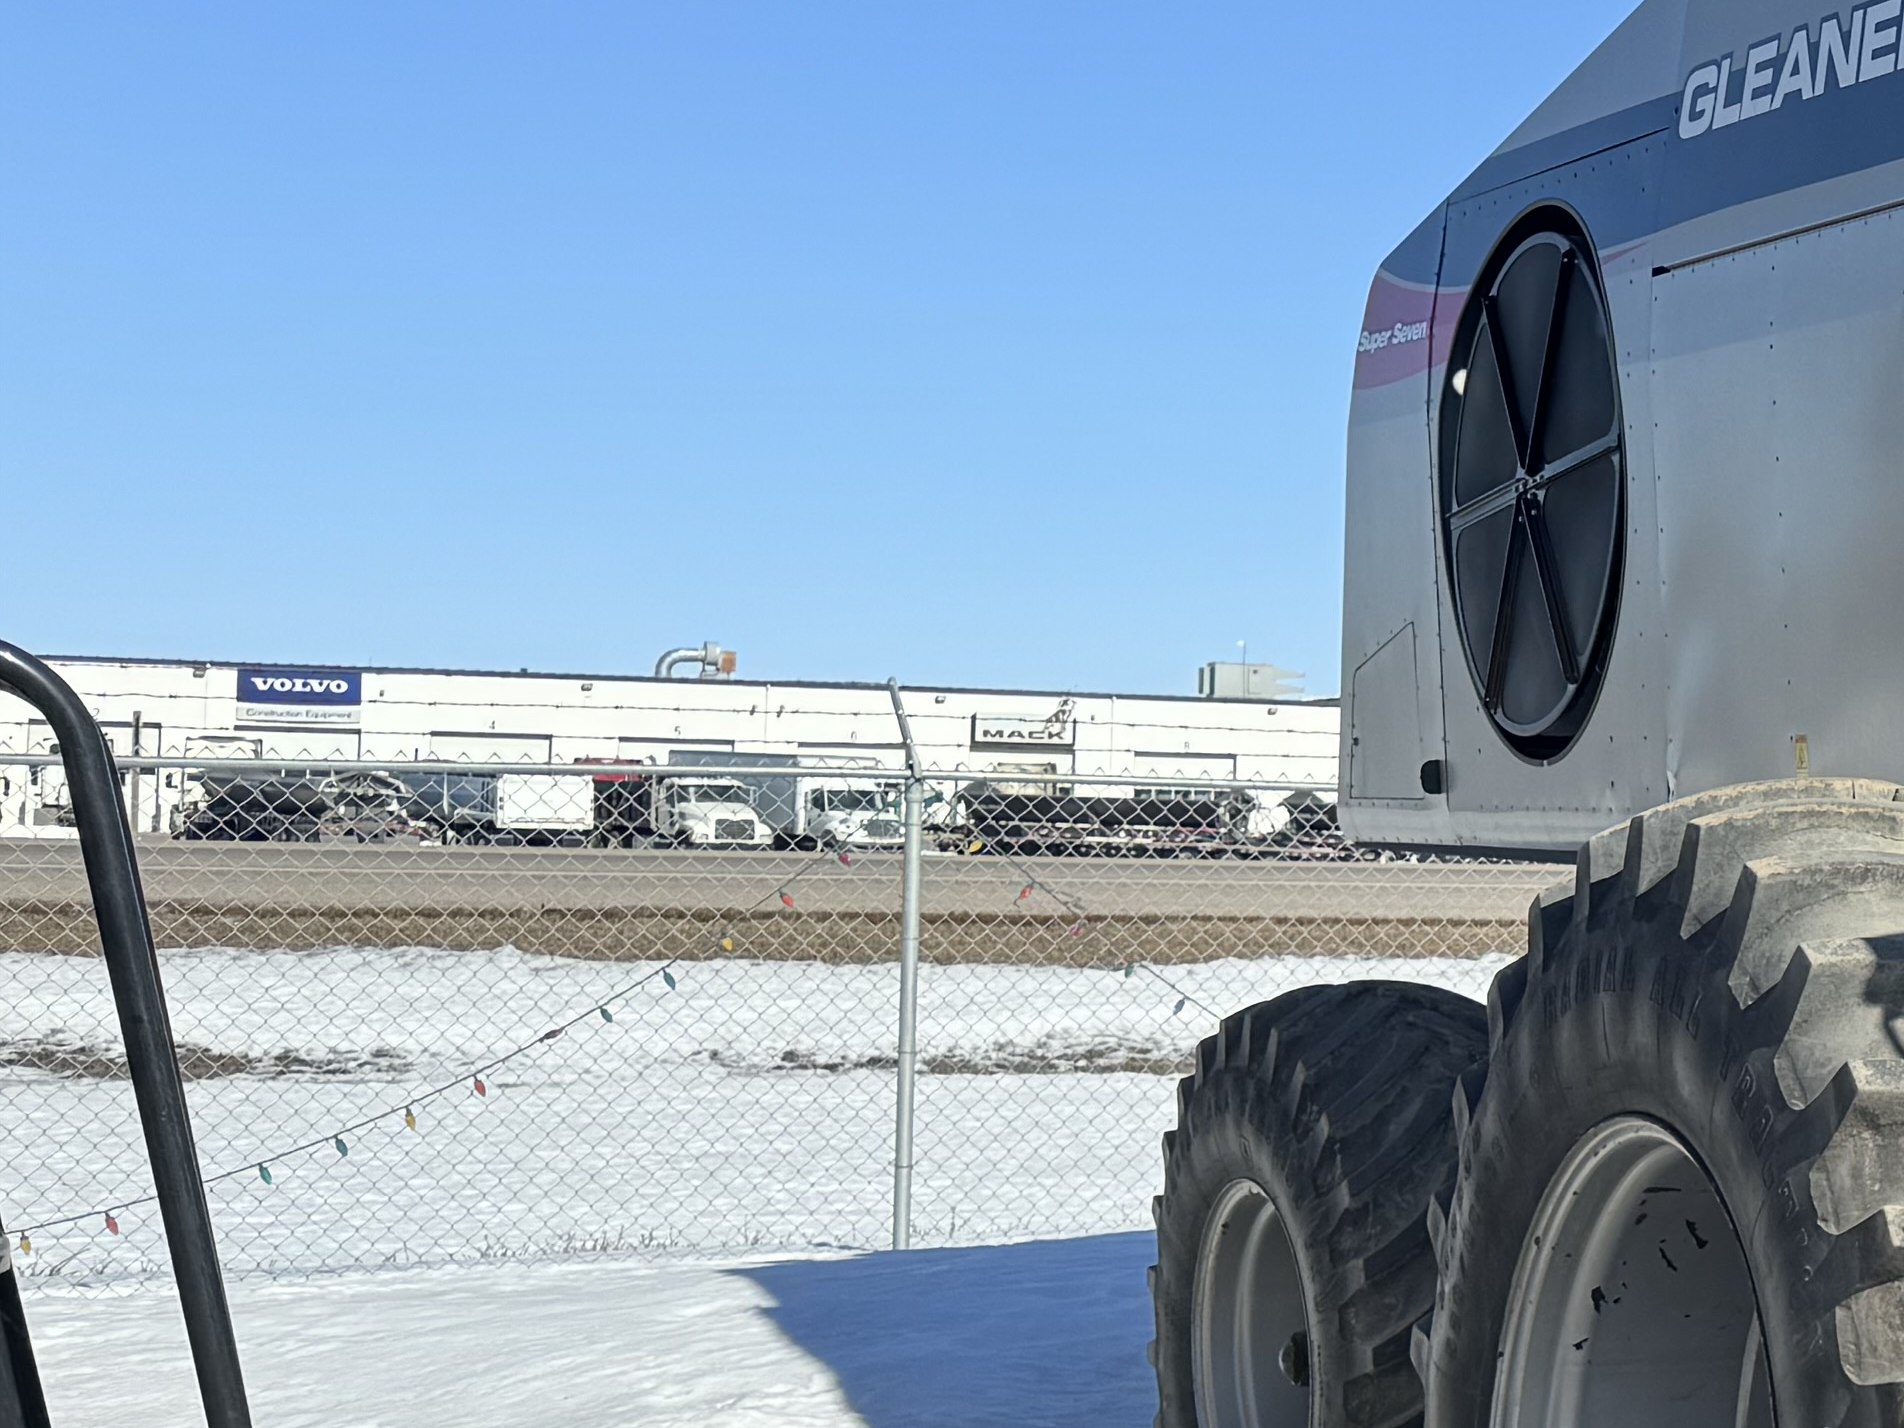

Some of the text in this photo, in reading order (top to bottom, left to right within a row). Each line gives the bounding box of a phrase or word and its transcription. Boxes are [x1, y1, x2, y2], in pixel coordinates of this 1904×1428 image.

[1358, 321, 1427, 354] Super Seven
[251, 677, 348, 693] VOLVO
[246, 708, 352, 719] Construction Equipment
[983, 729, 1064, 740] MACK
